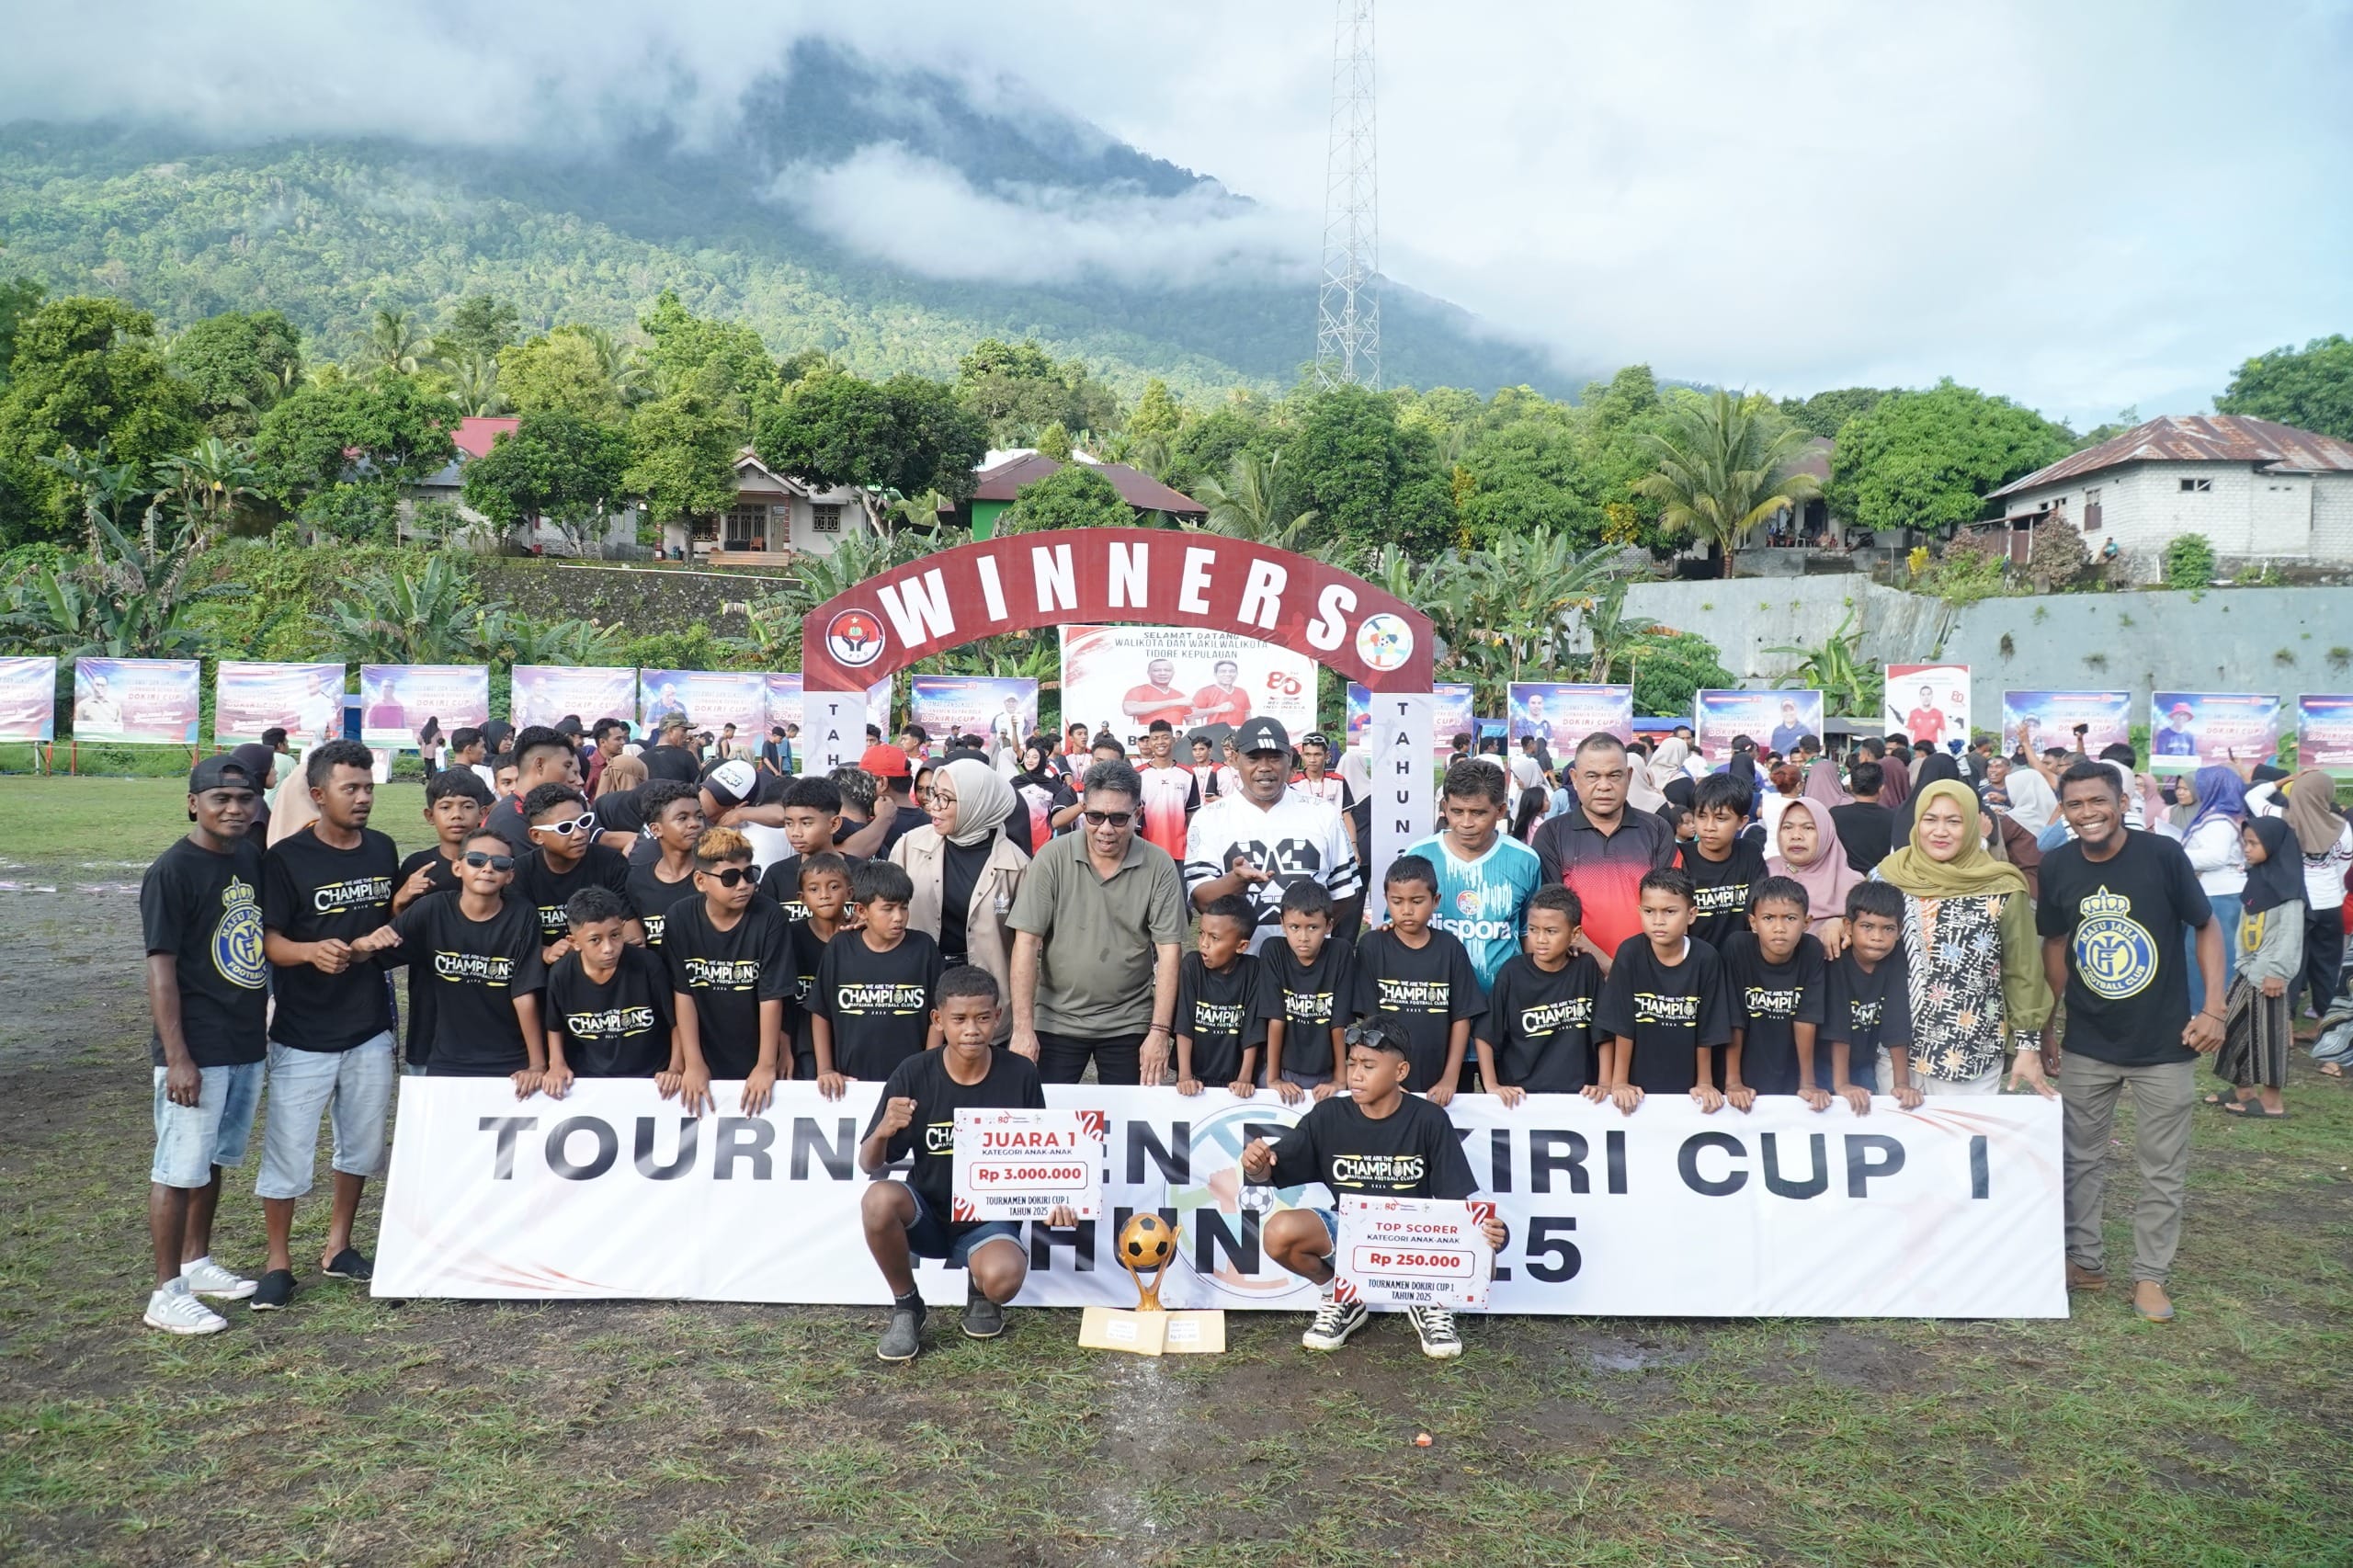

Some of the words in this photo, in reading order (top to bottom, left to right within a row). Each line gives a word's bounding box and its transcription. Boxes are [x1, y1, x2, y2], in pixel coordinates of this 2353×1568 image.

[877, 542, 1359, 652] WINNERS
[1115, 639, 1164, 647] WALIKOTA
[1166, 639, 1186, 647] DAN
[1146, 649, 1177, 658] TIDORE
[1182, 649, 1238, 659] KEPULAUAN
[1267, 671, 1302, 695] 80
[2079, 922, 2107, 945] MAFU
[2110, 922, 2139, 943] JAHA
[2084, 965, 2125, 990] FOOTBALL
[2124, 965, 2146, 985] CLUB
[568, 1009, 654, 1034] CHAMPIONS
[983, 1131, 1059, 1147] JUARA
[1068, 1131, 1075, 1147] 1
[1333, 1157, 1424, 1181] CHAMPIONS
[1677, 1131, 1906, 1199] CUP
[1969, 1135, 1990, 1199] I
[979, 1168, 1000, 1183] Rp
[1005, 1168, 1081, 1180] 3.000.000
[986, 1196, 1027, 1205] TOURNAMEN
[1029, 1196, 1051, 1205] DOKIRI
[1051, 1196, 1065, 1204] CUP
[1009, 1207, 1031, 1216] TAHUN
[1033, 1207, 1049, 1216] 2025
[1376, 1222, 1402, 1232] TOP
[1406, 1224, 1458, 1234] SCORER
[1367, 1233, 1409, 1243] KATEGORI
[1411, 1236, 1461, 1244] ANAK-ANAK
[1370, 1253, 1392, 1267] Rp
[1396, 1254, 1461, 1267] 250.000
[1369, 1278, 1410, 1290] TOURNAMEN
[1412, 1281, 1435, 1290] DOKIRI
[1436, 1283, 1449, 1291] CUP
[1392, 1291, 1415, 1300] TAHUN
[1416, 1292, 1432, 1301] 2025
